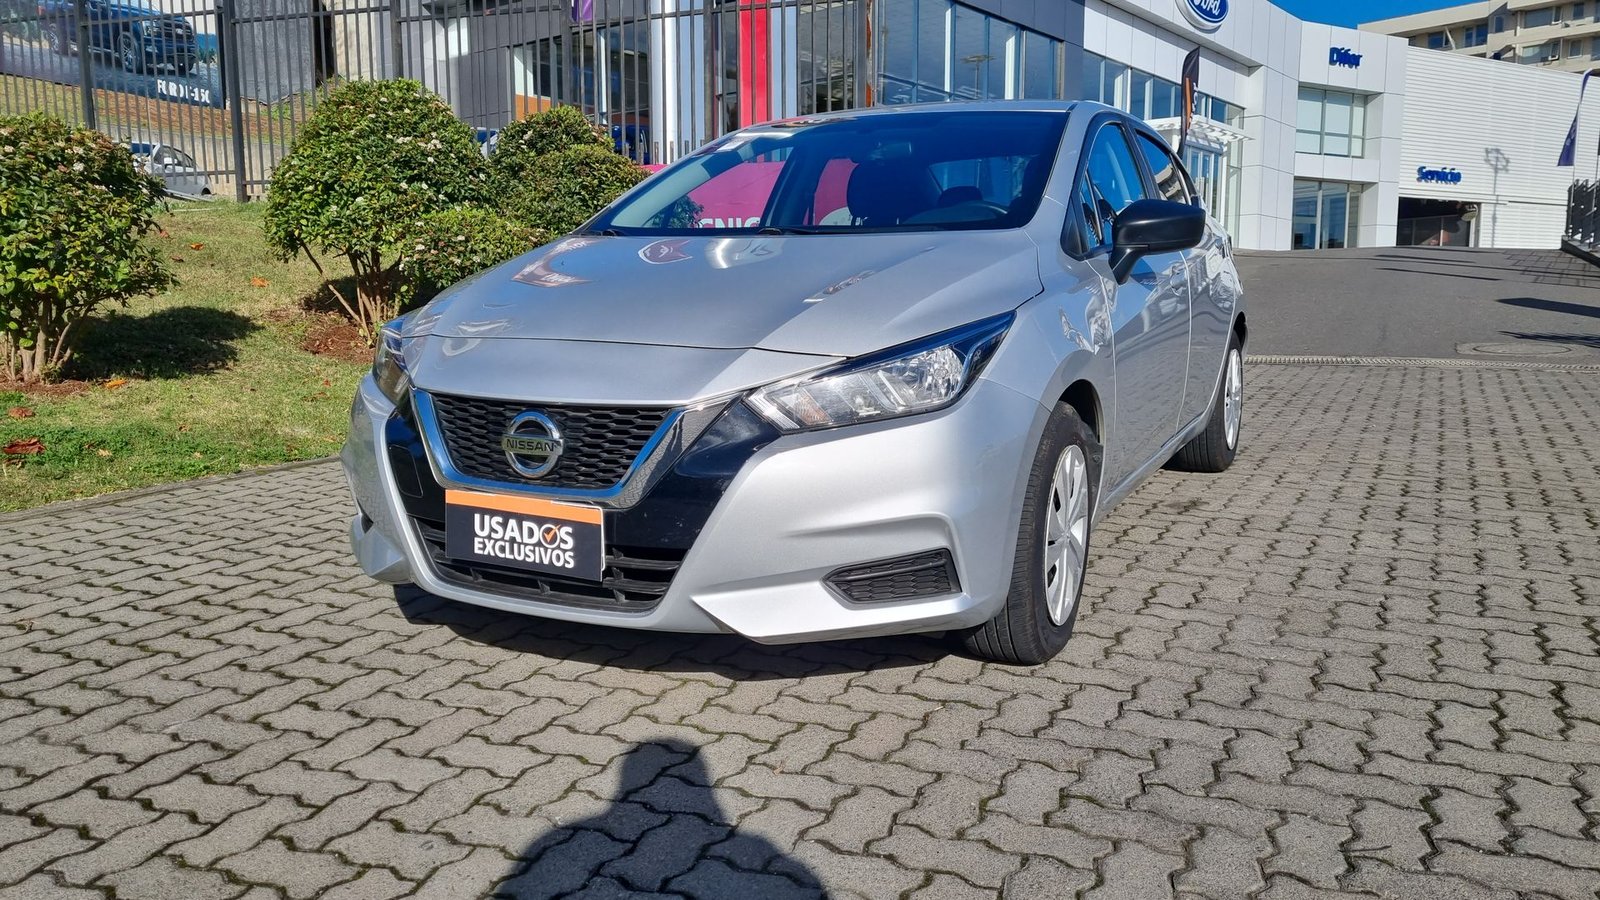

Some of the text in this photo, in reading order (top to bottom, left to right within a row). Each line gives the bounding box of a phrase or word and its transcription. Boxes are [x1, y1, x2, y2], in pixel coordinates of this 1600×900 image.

[1416, 166, 1462, 185] Servicio
[505, 438, 555, 453] NISSAN
[473, 513, 574, 551] USADOS
[473, 537, 576, 569] EXCLUSIVOS
